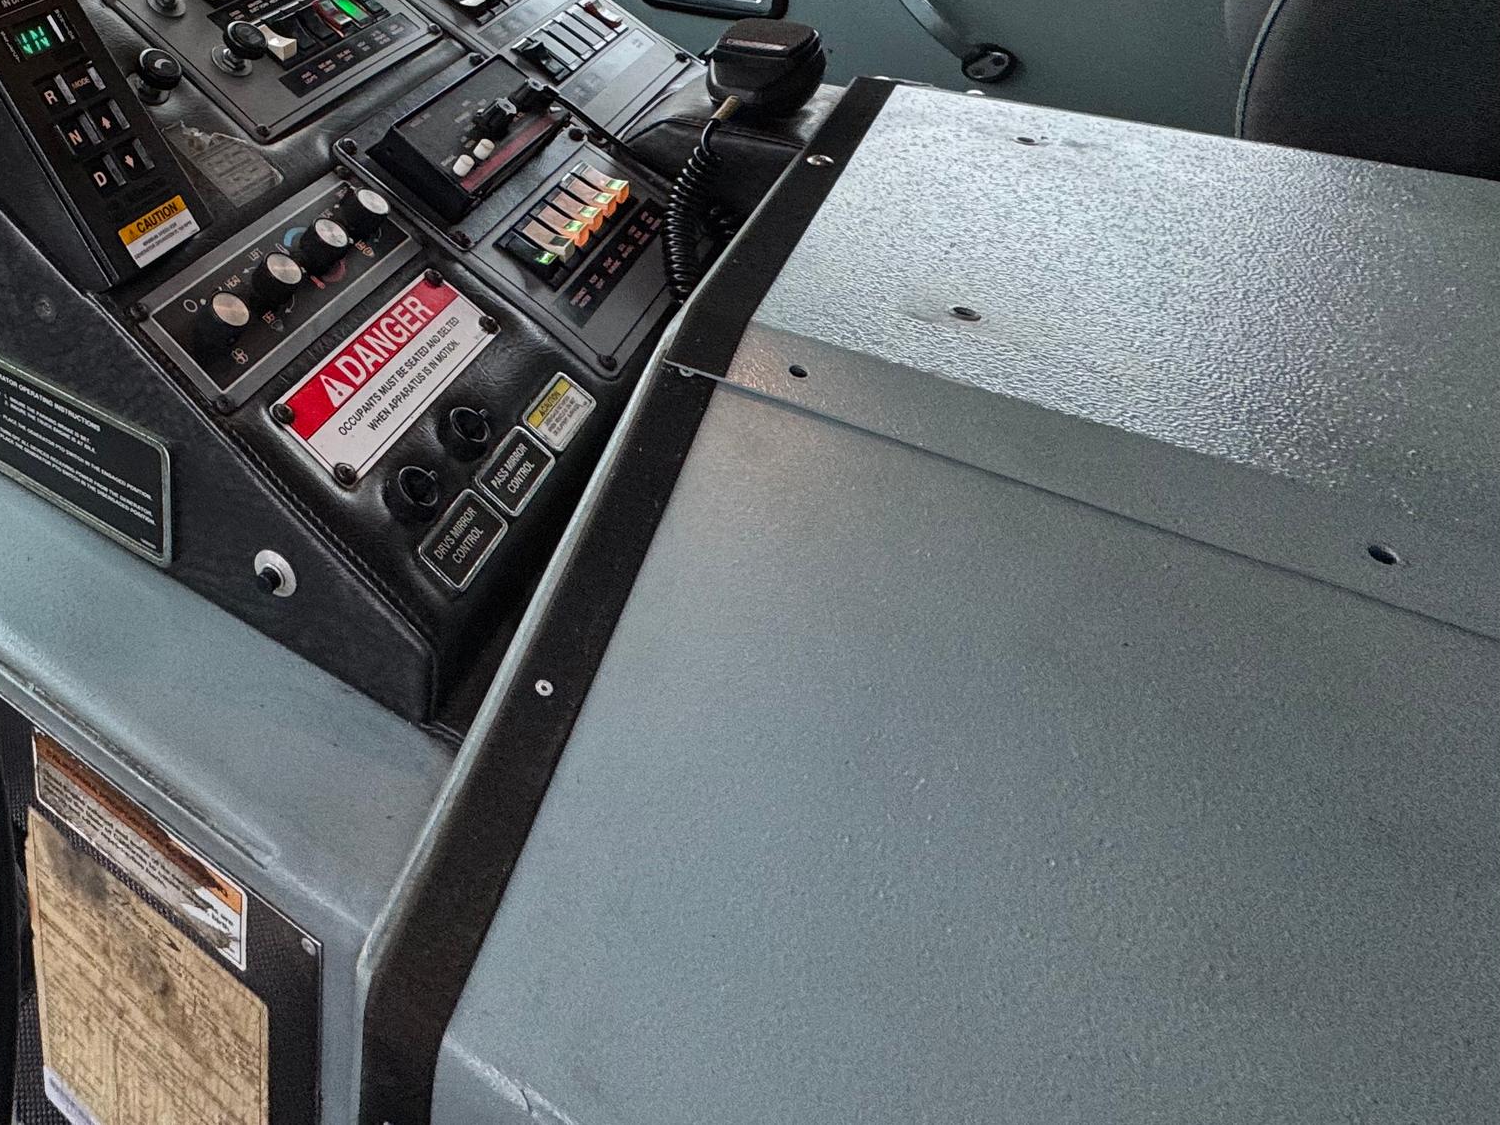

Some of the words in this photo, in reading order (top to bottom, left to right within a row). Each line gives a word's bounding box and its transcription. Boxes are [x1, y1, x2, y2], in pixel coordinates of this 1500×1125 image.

[43, 89, 58, 106] R
[71, 76, 90, 90] MODE
[68, 129, 83, 145] N
[93, 171, 107, 187] D
[135, 201, 178, 233] CAUTION
[223, 274, 242, 289] HEAT
[332, 293, 435, 386] DANGER
[336, 391, 382, 436] OCCUPANTS
[377, 374, 400, 396] MUST
[394, 366, 408, 379] BE
[403, 345, 430, 370] SEATED
[424, 333, 441, 349] AND
[366, 406, 392, 432] WHEN
[386, 371, 427, 411] APPARATUS
[421, 365, 432, 376] IS
[427, 358, 439, 370] IN
[433, 337, 460, 363] MOTION.
[18, 382, 53, 407] OPERATING
[54, 401, 100, 432] INSTRUCTIONS
[489, 466, 510, 489] PASS
[502, 441, 529, 471] MIRROR
[505, 458, 536, 494] CONTROL
[432, 534, 455, 560] DRVS
[448, 505, 477, 539] MIRROR
[450, 524, 485, 565] CONTROL
